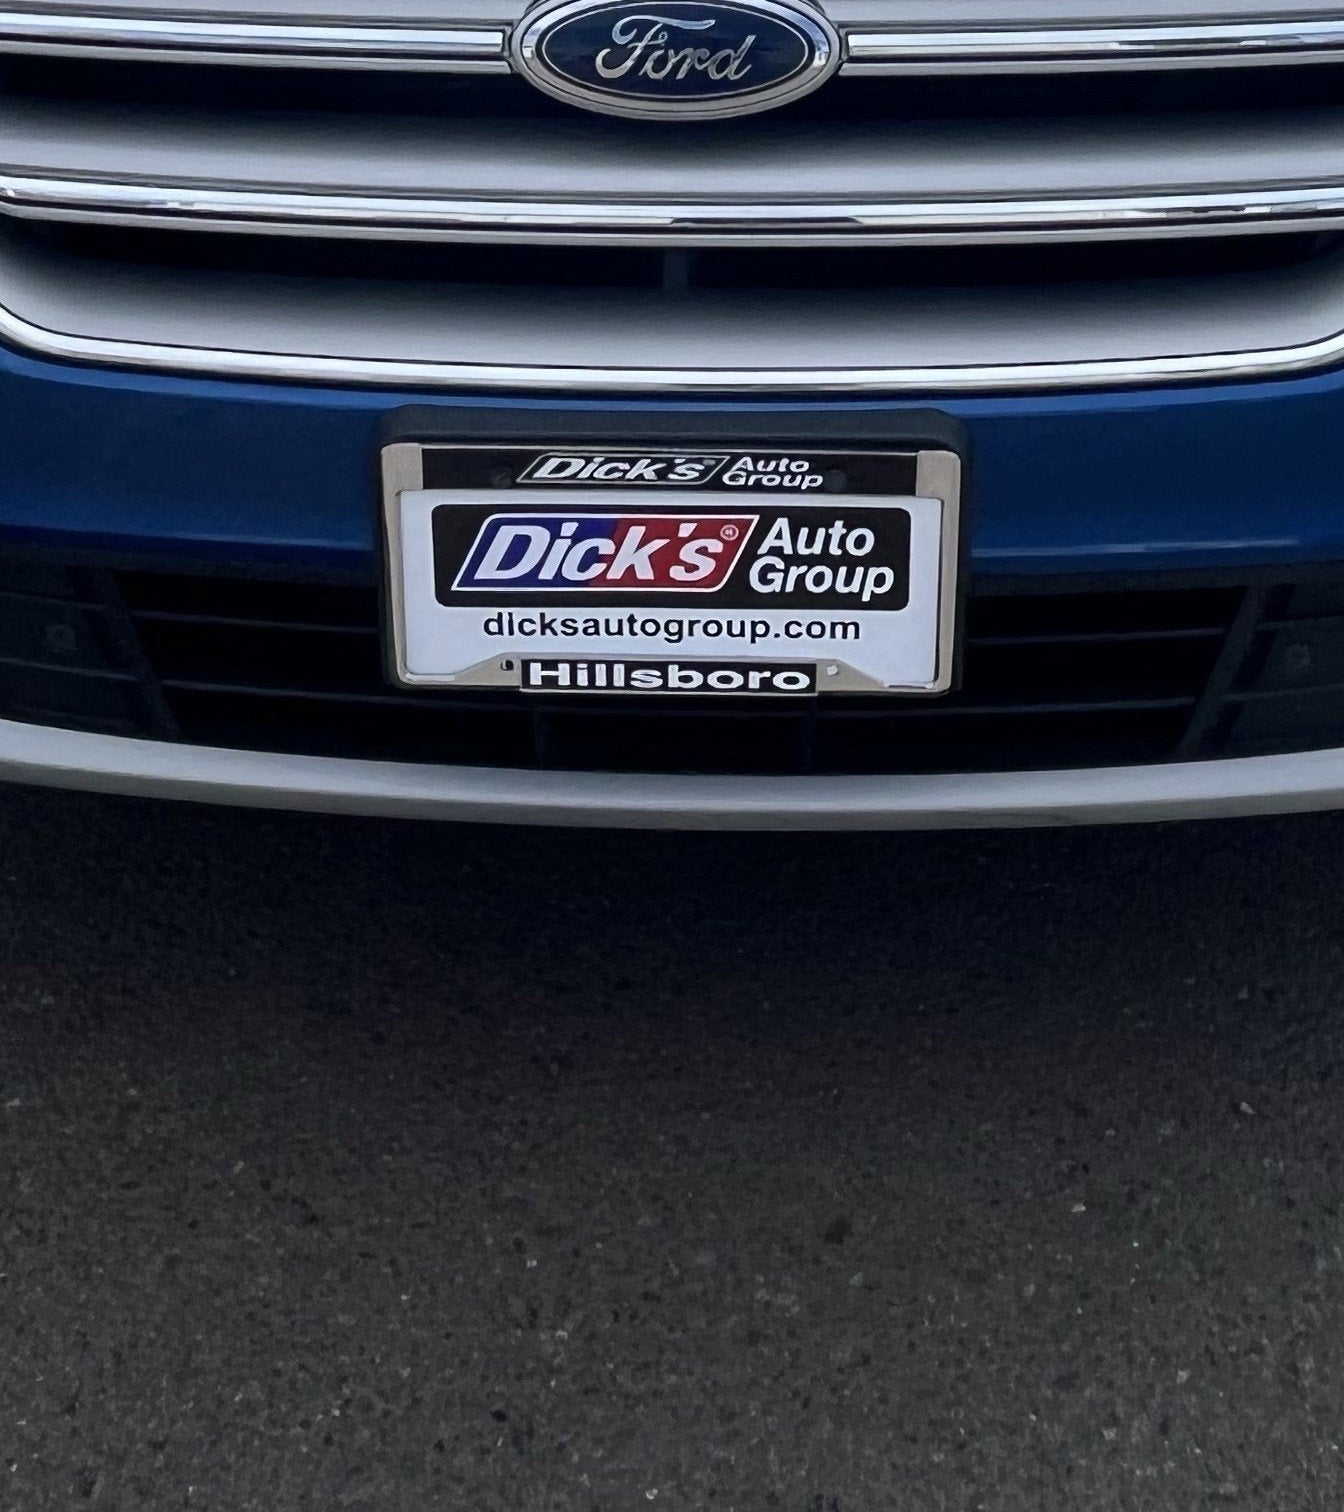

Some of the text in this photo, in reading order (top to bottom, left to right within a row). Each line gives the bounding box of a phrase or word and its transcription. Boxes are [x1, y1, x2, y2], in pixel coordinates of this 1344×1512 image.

[594, 14, 757, 80] Ford
[532, 456, 707, 481] Dick's
[721, 470, 824, 490] Group
[731, 456, 810, 473] Auto
[473, 521, 724, 582] Dick's
[757, 517, 875, 557] Auto
[748, 555, 895, 602] Group
[482, 611, 861, 644] dicksautogroup.com
[527, 662, 811, 690] Hillsboro
